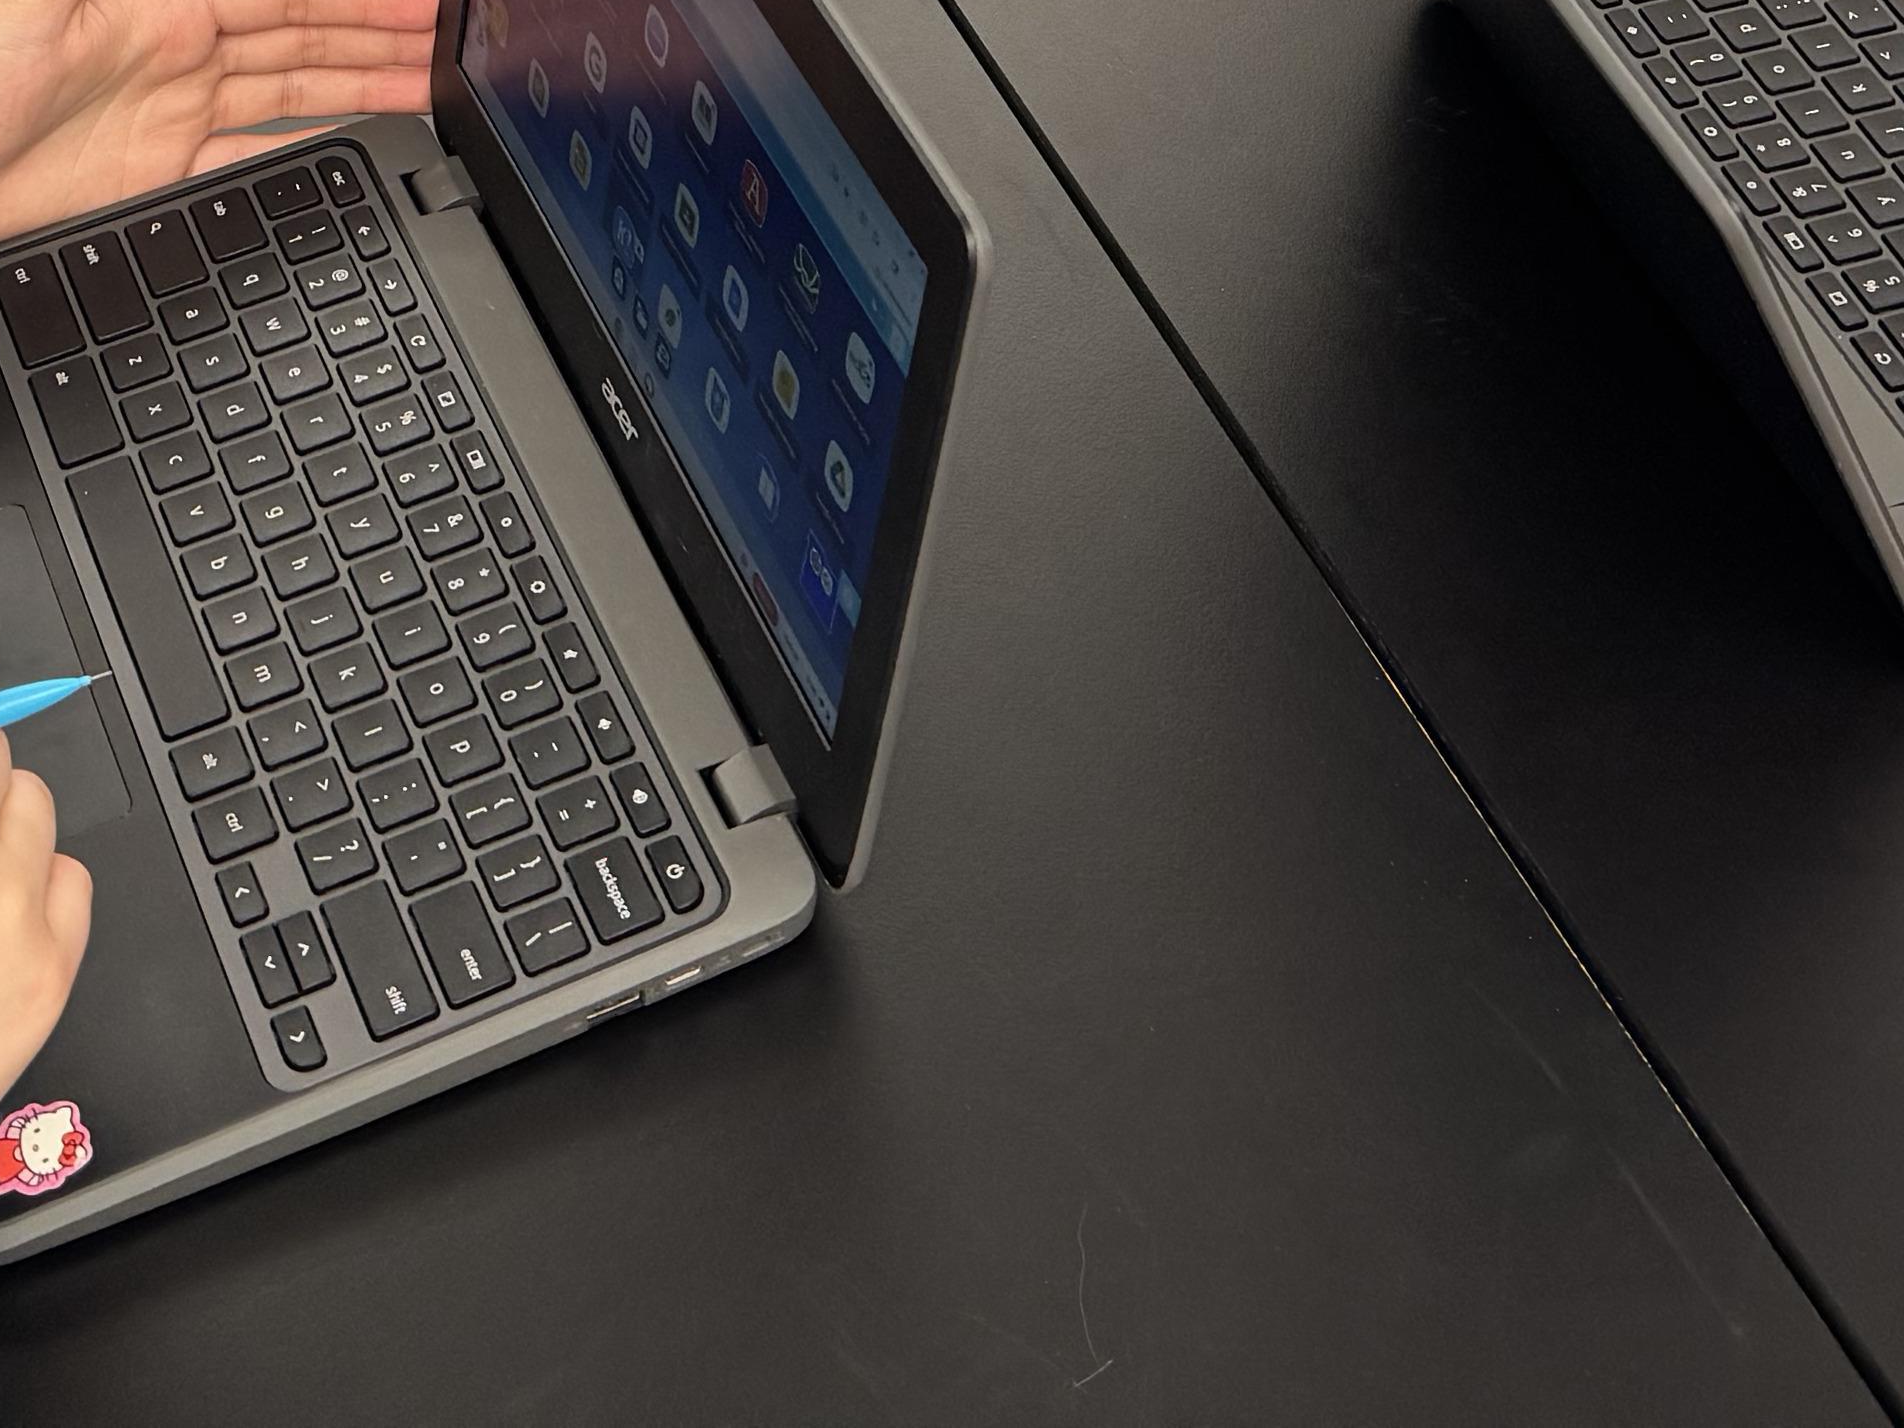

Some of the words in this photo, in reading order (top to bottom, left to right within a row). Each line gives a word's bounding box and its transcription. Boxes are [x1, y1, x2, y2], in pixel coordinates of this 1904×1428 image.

[15, 266, 30, 284] ctrl
[600, 377, 640, 443] acer
[226, 811, 243, 833] ctrl
[594, 856, 631, 921] backspace
[459, 947, 484, 982] enter
[385, 984, 407, 1015] shift
